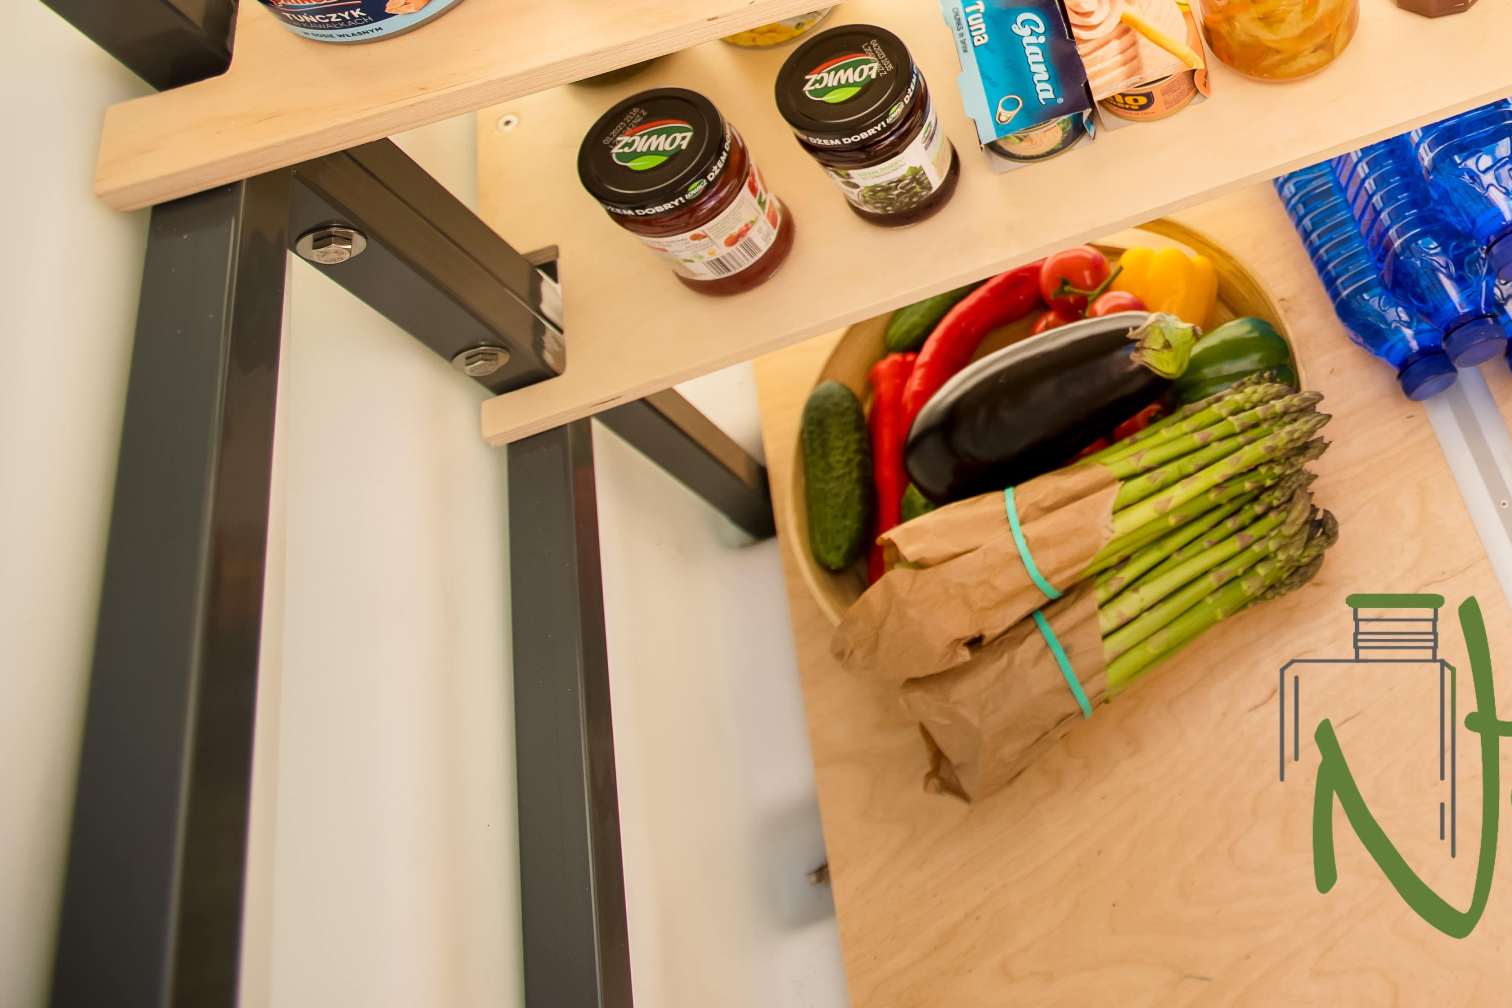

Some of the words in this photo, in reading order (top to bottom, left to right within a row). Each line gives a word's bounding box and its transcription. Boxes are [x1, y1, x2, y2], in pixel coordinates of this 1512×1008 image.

[282, 8, 368, 23] TUŃCZYK
[965, 0, 989, 47] Tuna
[1011, 11, 1056, 105] Giana
[803, 62, 879, 91] ŁOWICZ
[611, 132, 693, 153] ŁOWICZ
[808, 136, 841, 146] DŻEM
[707, 154, 728, 182] DŻEM
